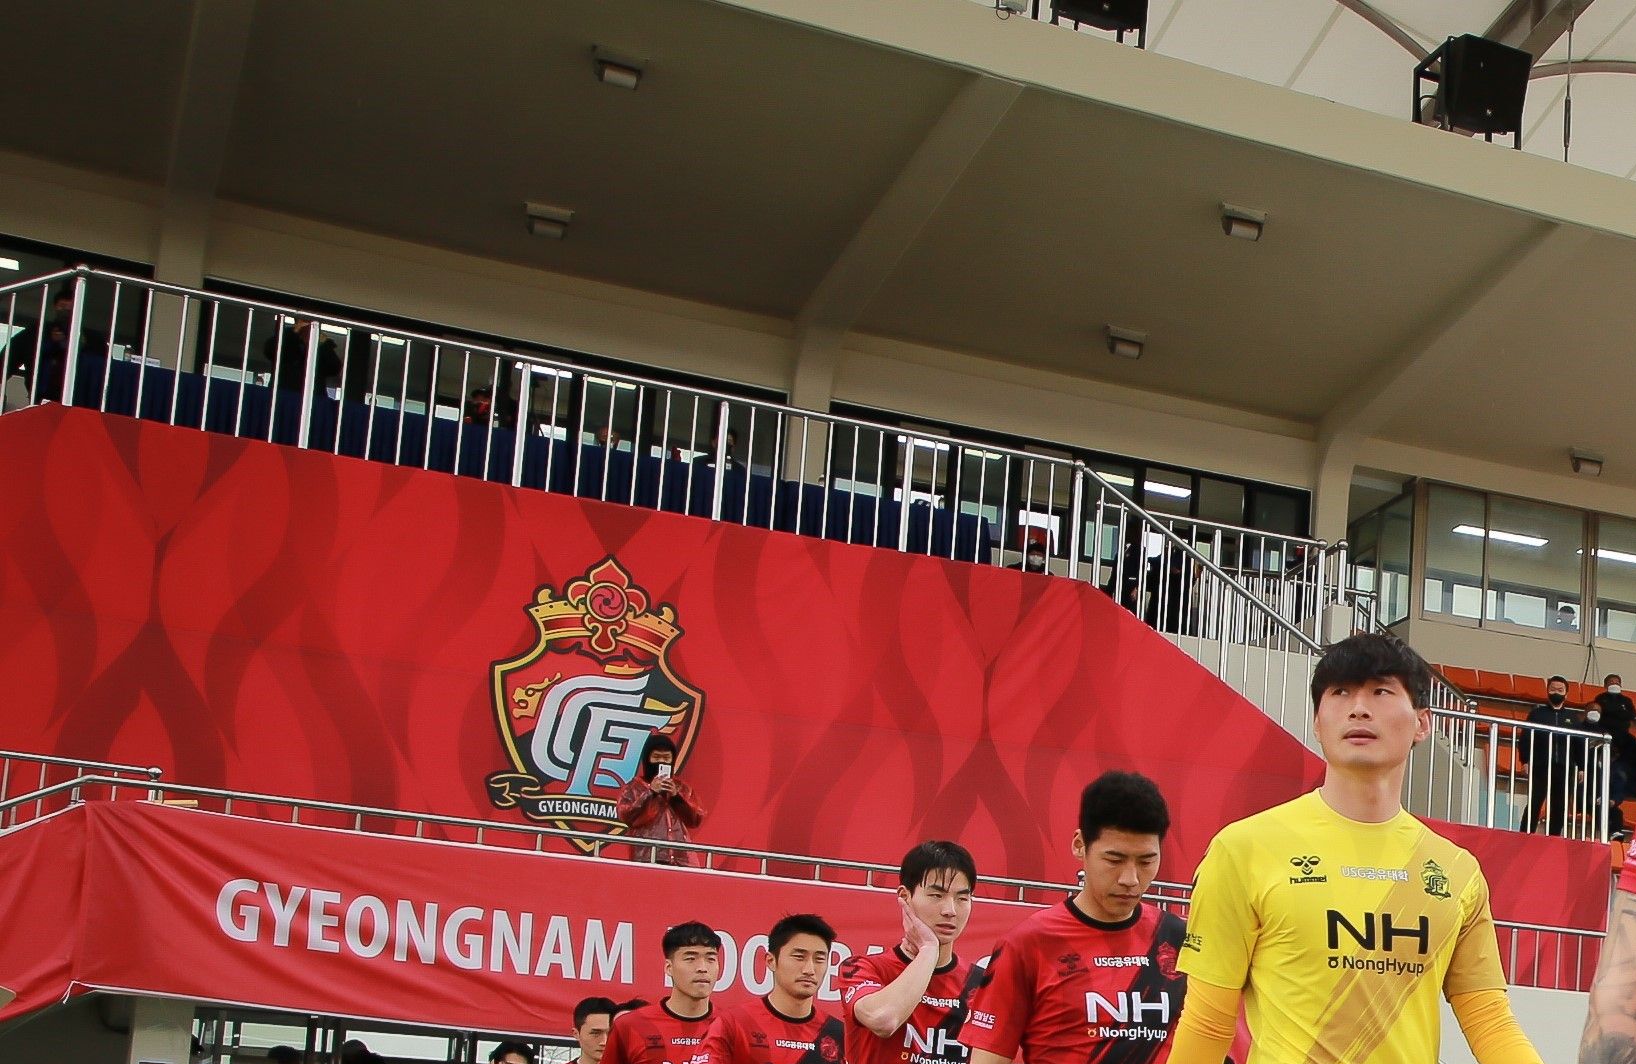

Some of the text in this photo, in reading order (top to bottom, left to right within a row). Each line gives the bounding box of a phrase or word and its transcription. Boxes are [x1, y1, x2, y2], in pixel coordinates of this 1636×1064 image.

[538, 800, 618, 819] GYEONGNAM
[1289, 874, 1327, 885] hummel
[1341, 866, 1409, 882] USG공유대학
[215, 878, 635, 985] GYEONGNAM
[1326, 909, 1430, 955] NH
[1343, 956, 1425, 977] NongHyup
[1085, 991, 1170, 1024] NH
[903, 1023, 969, 1058] NH
[1099, 1026, 1168, 1042] NongHyup
